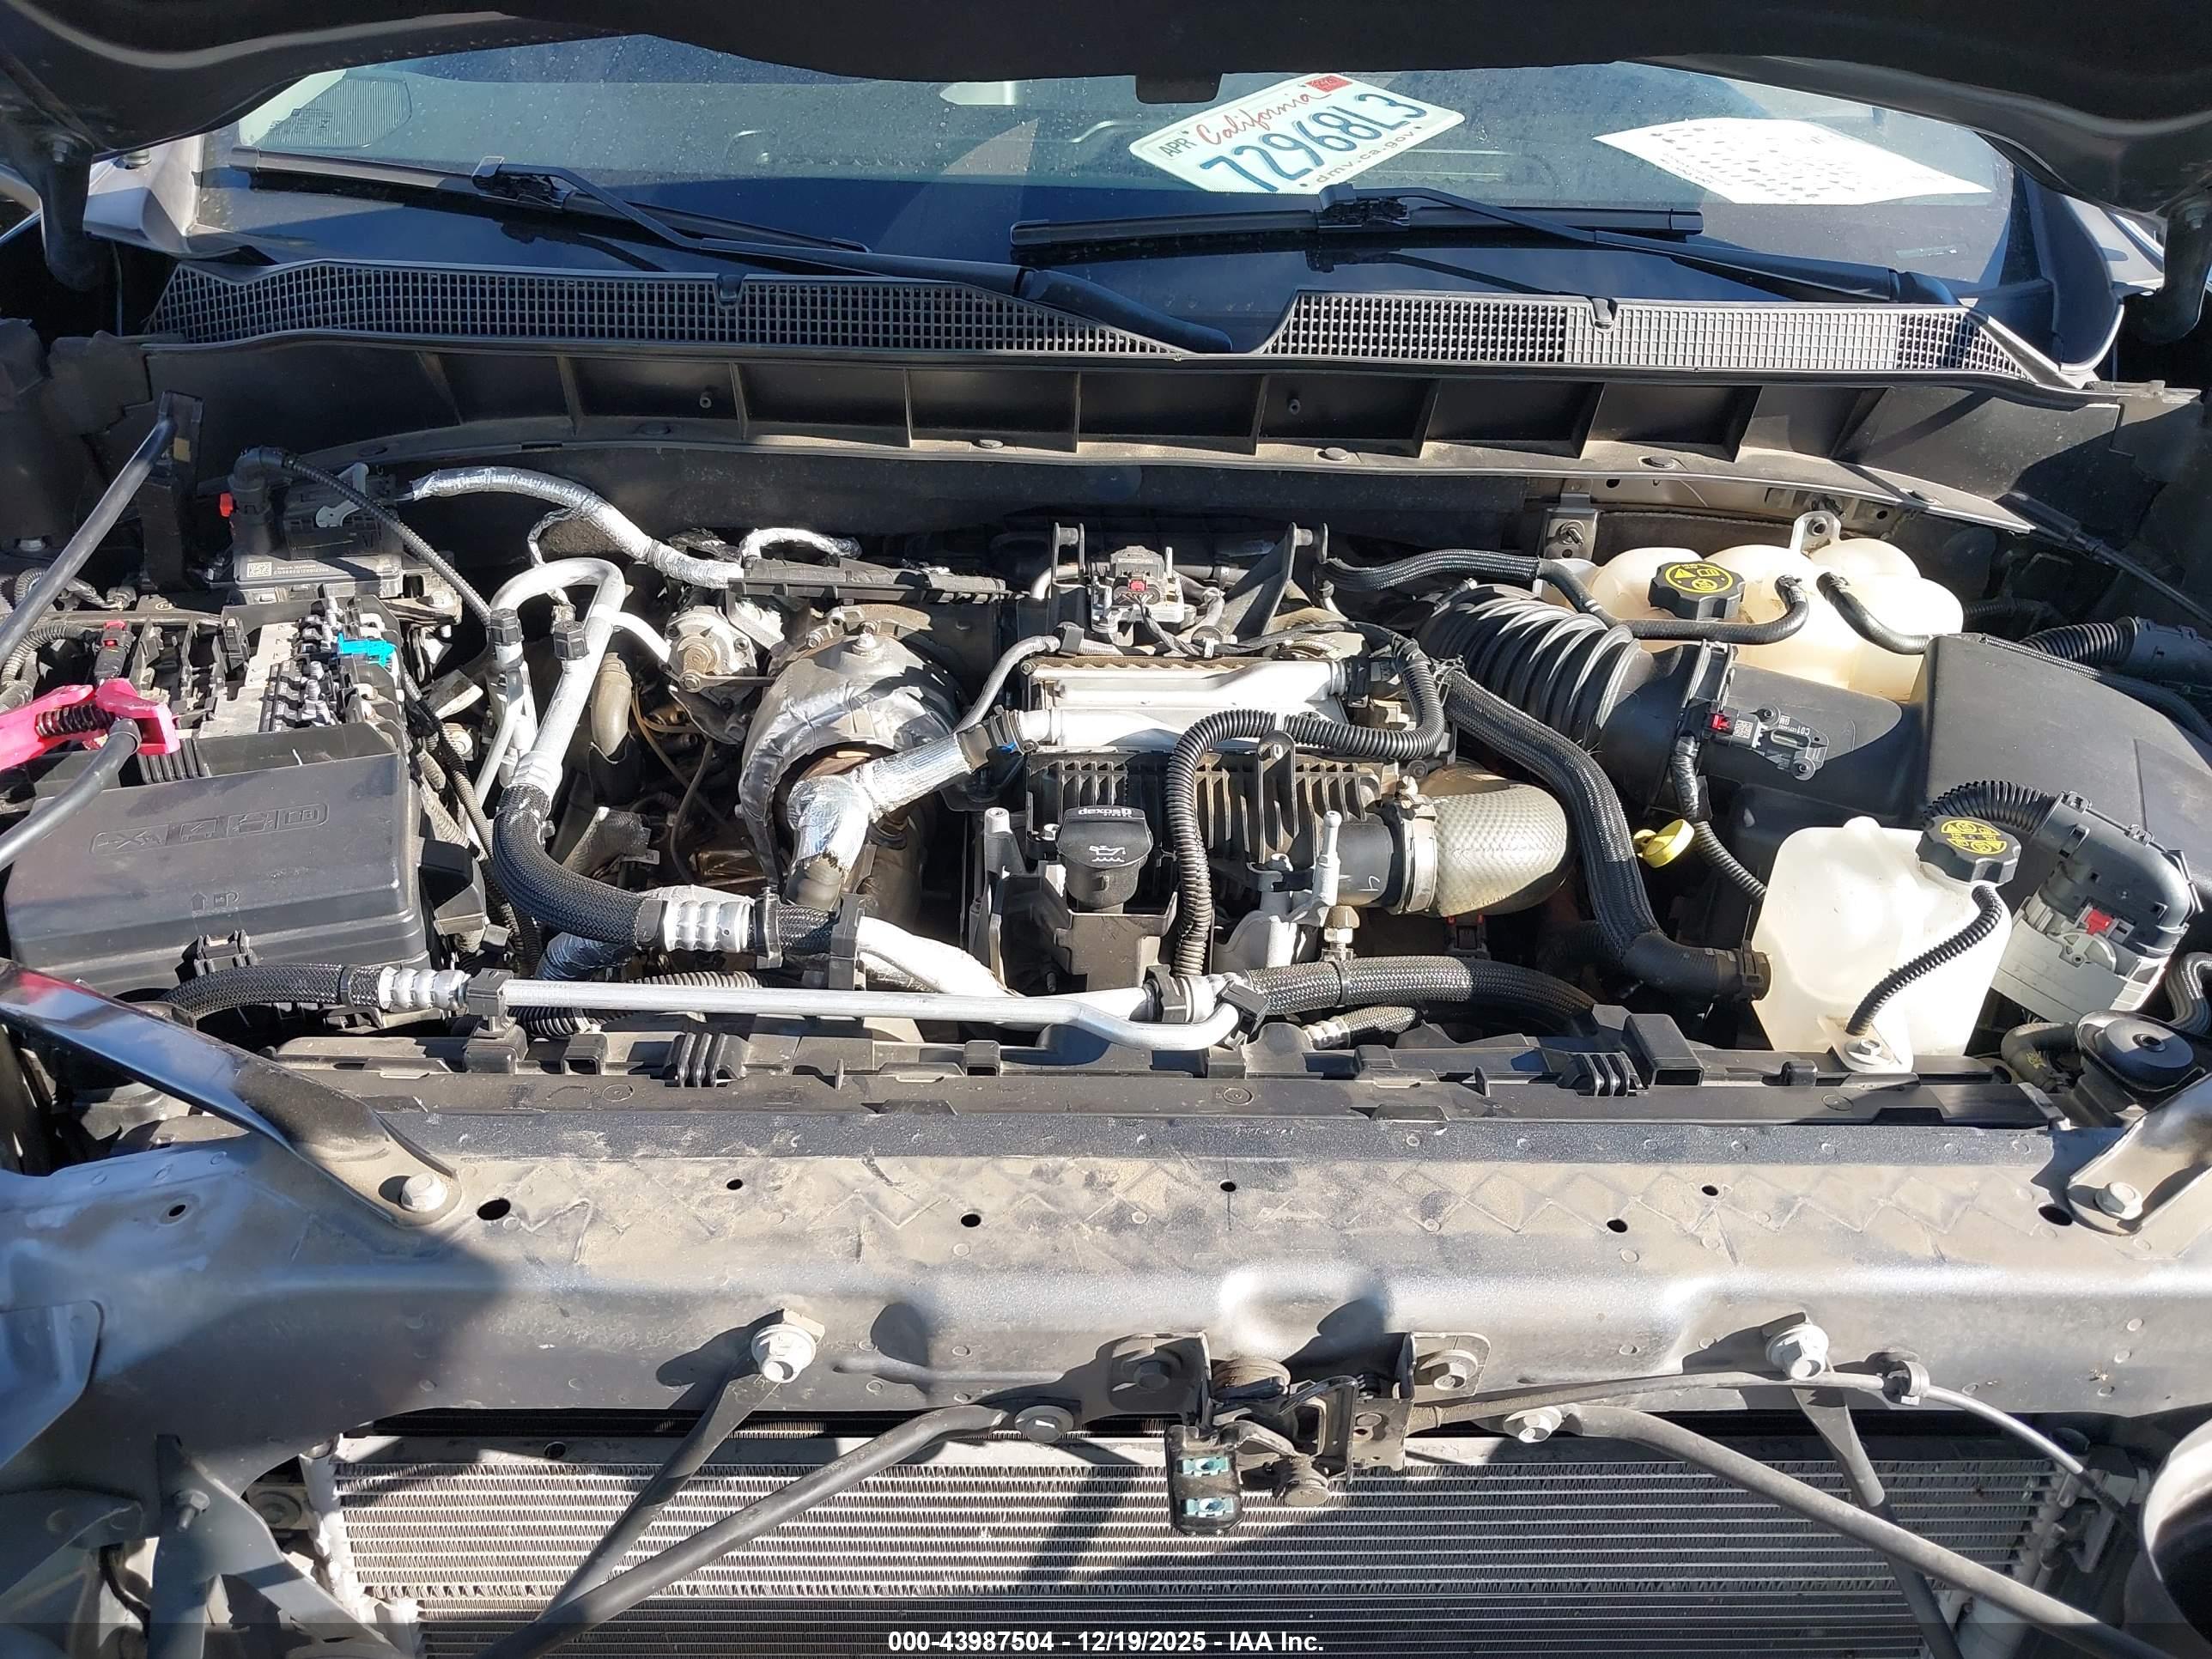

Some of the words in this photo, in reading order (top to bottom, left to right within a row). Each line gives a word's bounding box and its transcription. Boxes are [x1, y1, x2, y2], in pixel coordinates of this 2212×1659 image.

[1196, 94, 1332, 145] California
[1200, 94, 1427, 192] 72968L3
[1158, 137, 1198, 157] APR
